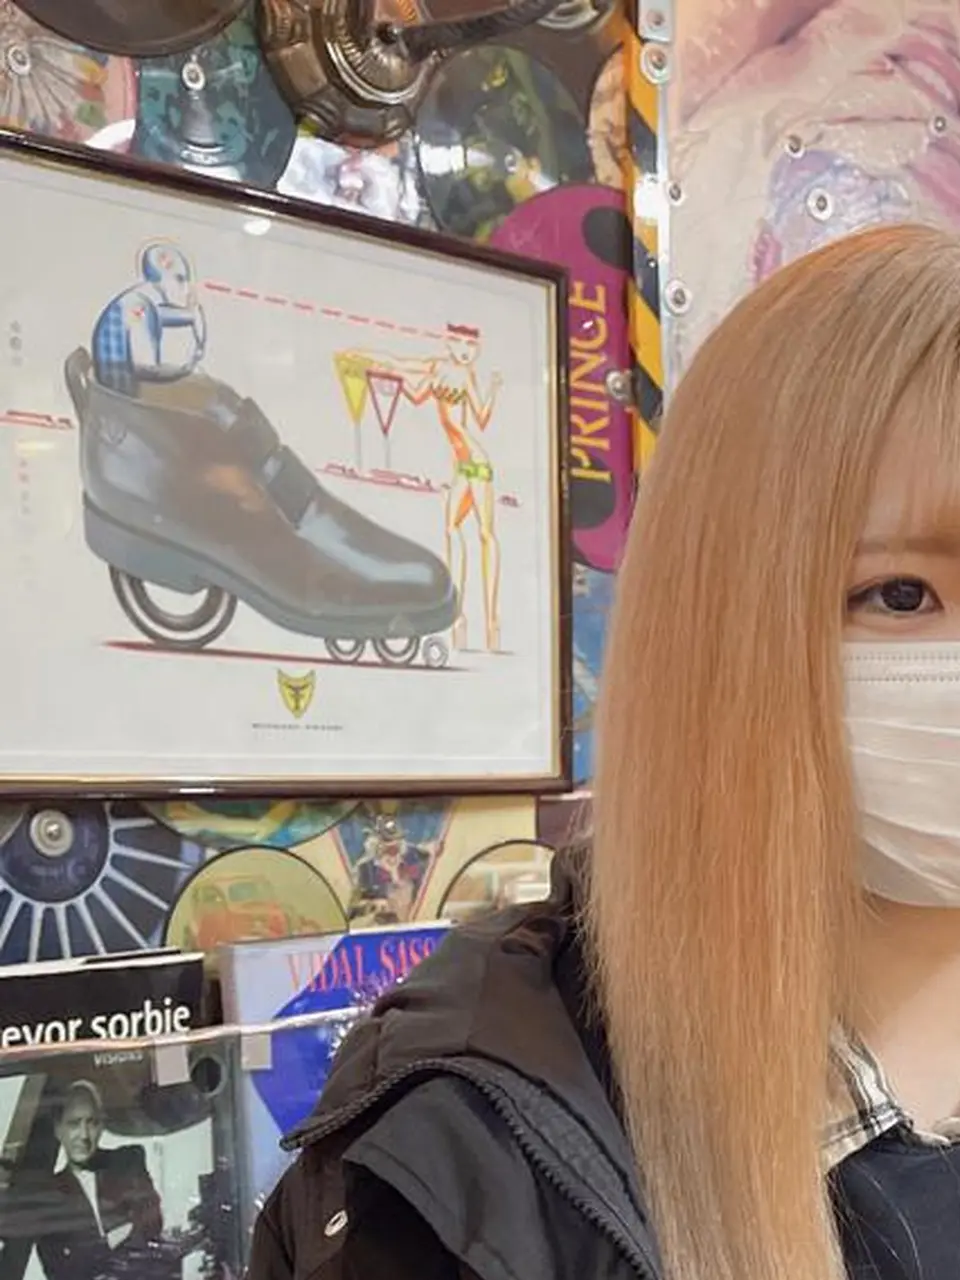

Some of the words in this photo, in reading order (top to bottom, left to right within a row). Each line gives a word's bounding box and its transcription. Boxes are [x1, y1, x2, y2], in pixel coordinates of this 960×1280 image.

[568, 280, 611, 484] PRINCE
[287, 946, 366, 992] VIDAL
[91, 999, 191, 1040] sorbie
